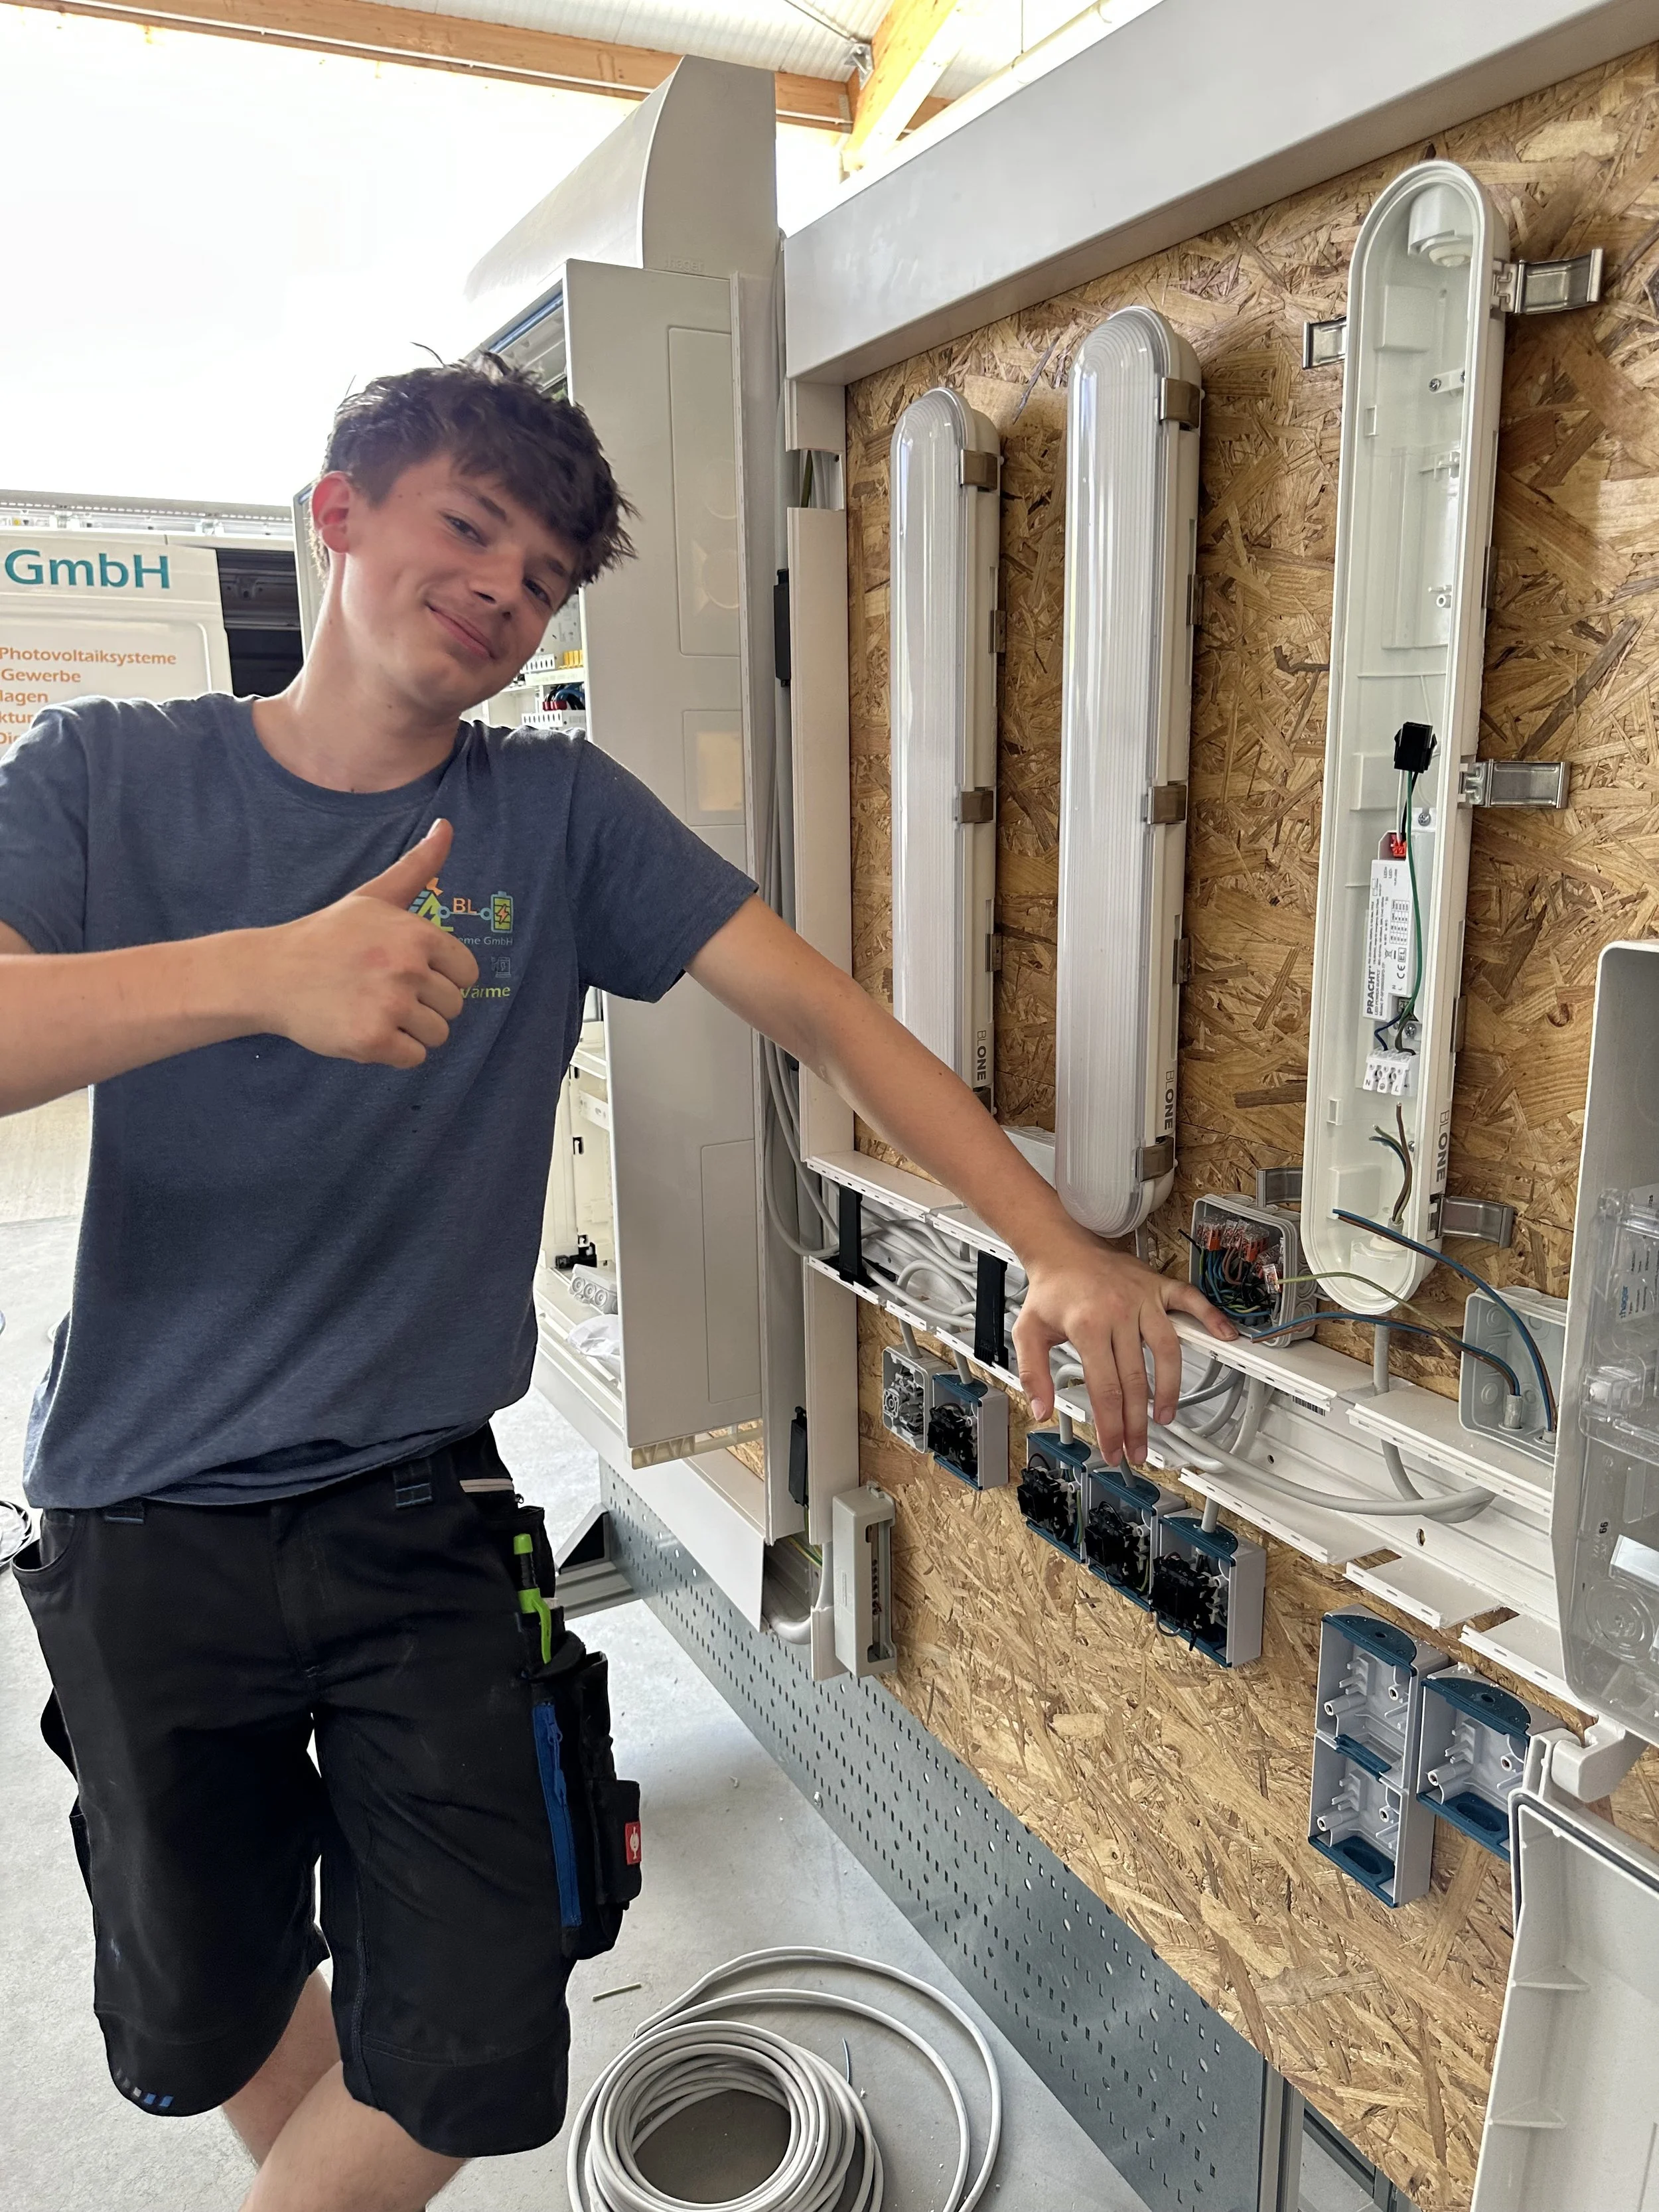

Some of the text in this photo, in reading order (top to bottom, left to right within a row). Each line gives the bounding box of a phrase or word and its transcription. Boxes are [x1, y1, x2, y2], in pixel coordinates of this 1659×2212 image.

[5, 549, 171, 589] GmbH
[0, 647, 177, 667] Photovoltaiksysteme
[1, 668, 81, 683] Gewerbe
[0, 689, 48, 706] lagen
[484, 936, 513, 946] GmbH
[1366, 968, 1376, 1015] PRACHT
